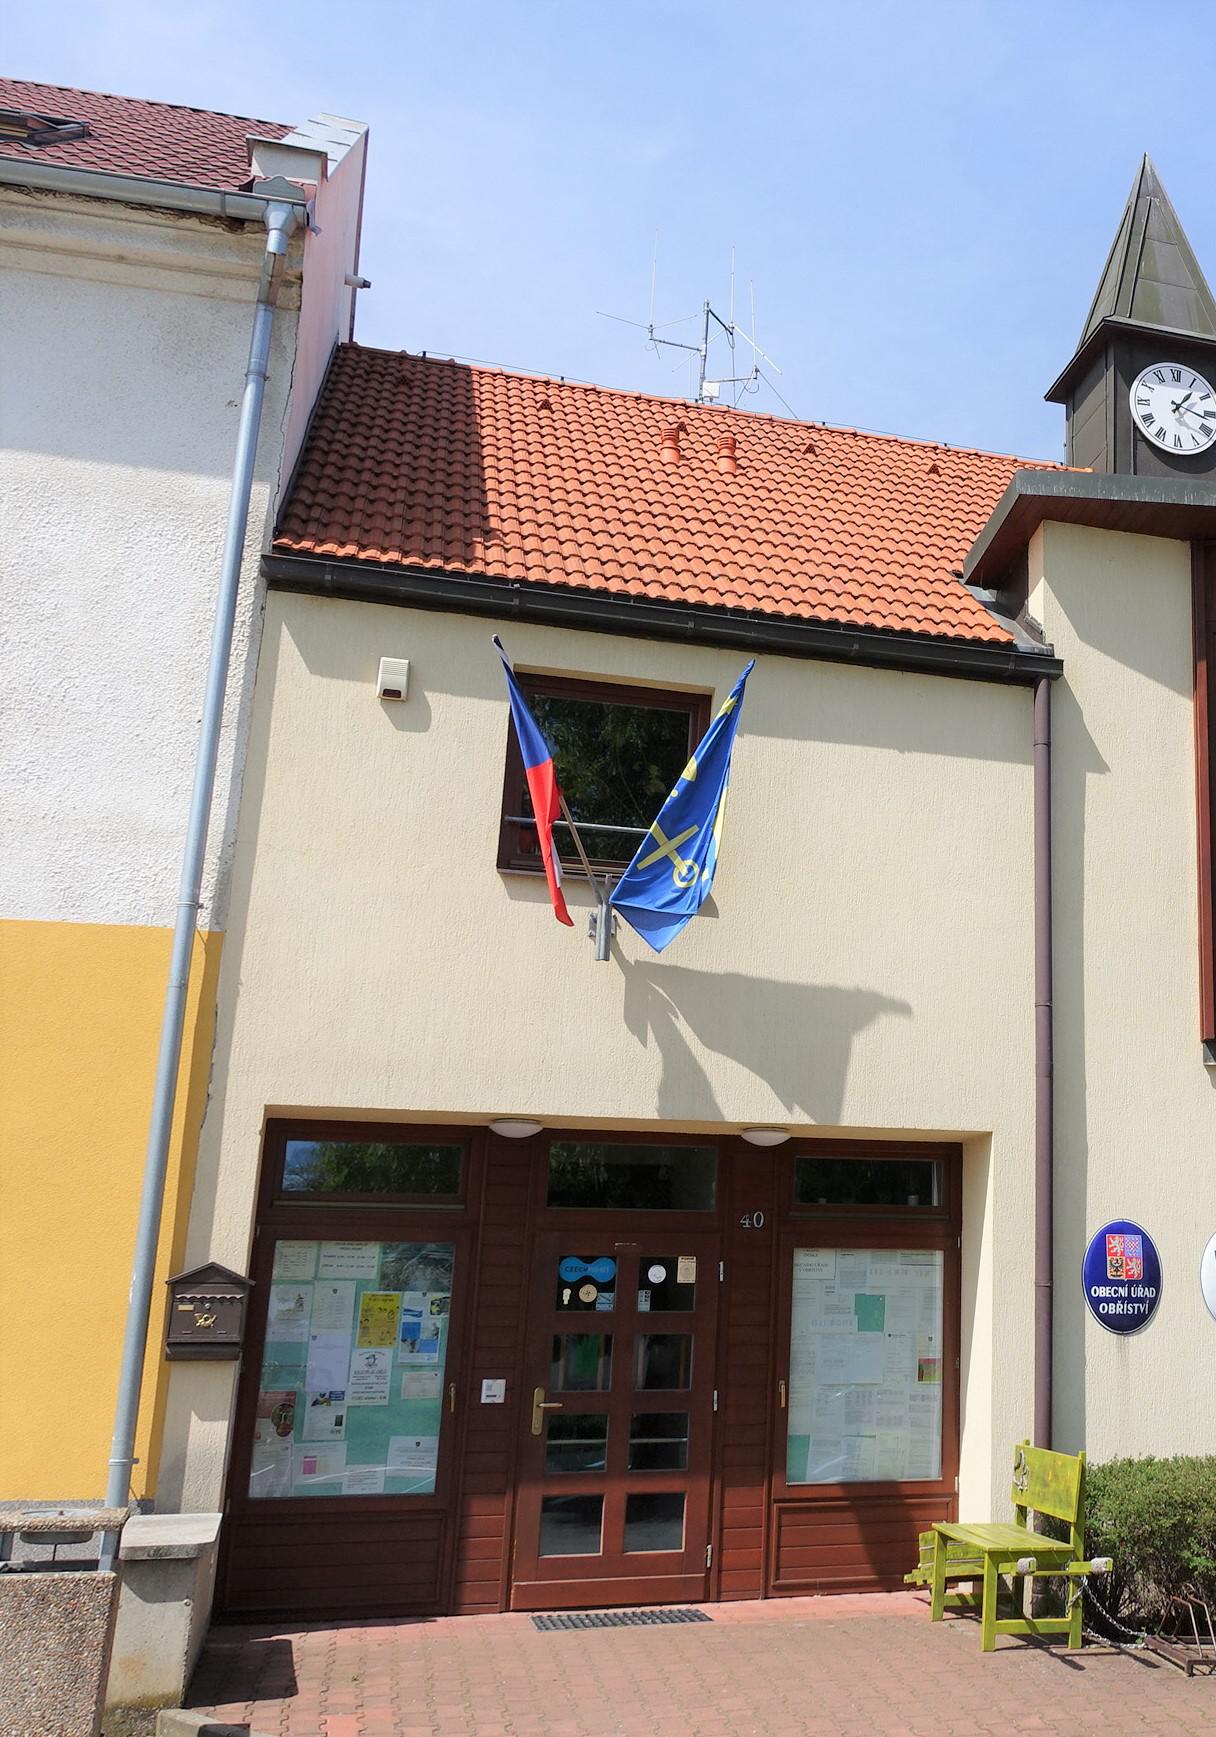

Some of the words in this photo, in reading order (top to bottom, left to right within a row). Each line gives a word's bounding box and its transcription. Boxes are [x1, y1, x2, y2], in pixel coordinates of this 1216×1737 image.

[1153, 369, 1166, 384] XI
[1170, 368, 1182, 383] XII
[1141, 380, 1155, 392] X
[1137, 396, 1151, 406] IX
[1154, 426, 1167, 442] VII
[1173, 434, 1183, 448] VI
[740, 1211, 764, 1228] 40
[1091, 1284, 1128, 1298] OBECNÍ
[1131, 1284, 1156, 1298] ÚŘAD
[1099, 1300, 1149, 1315] OBŘÍSTVÍ
